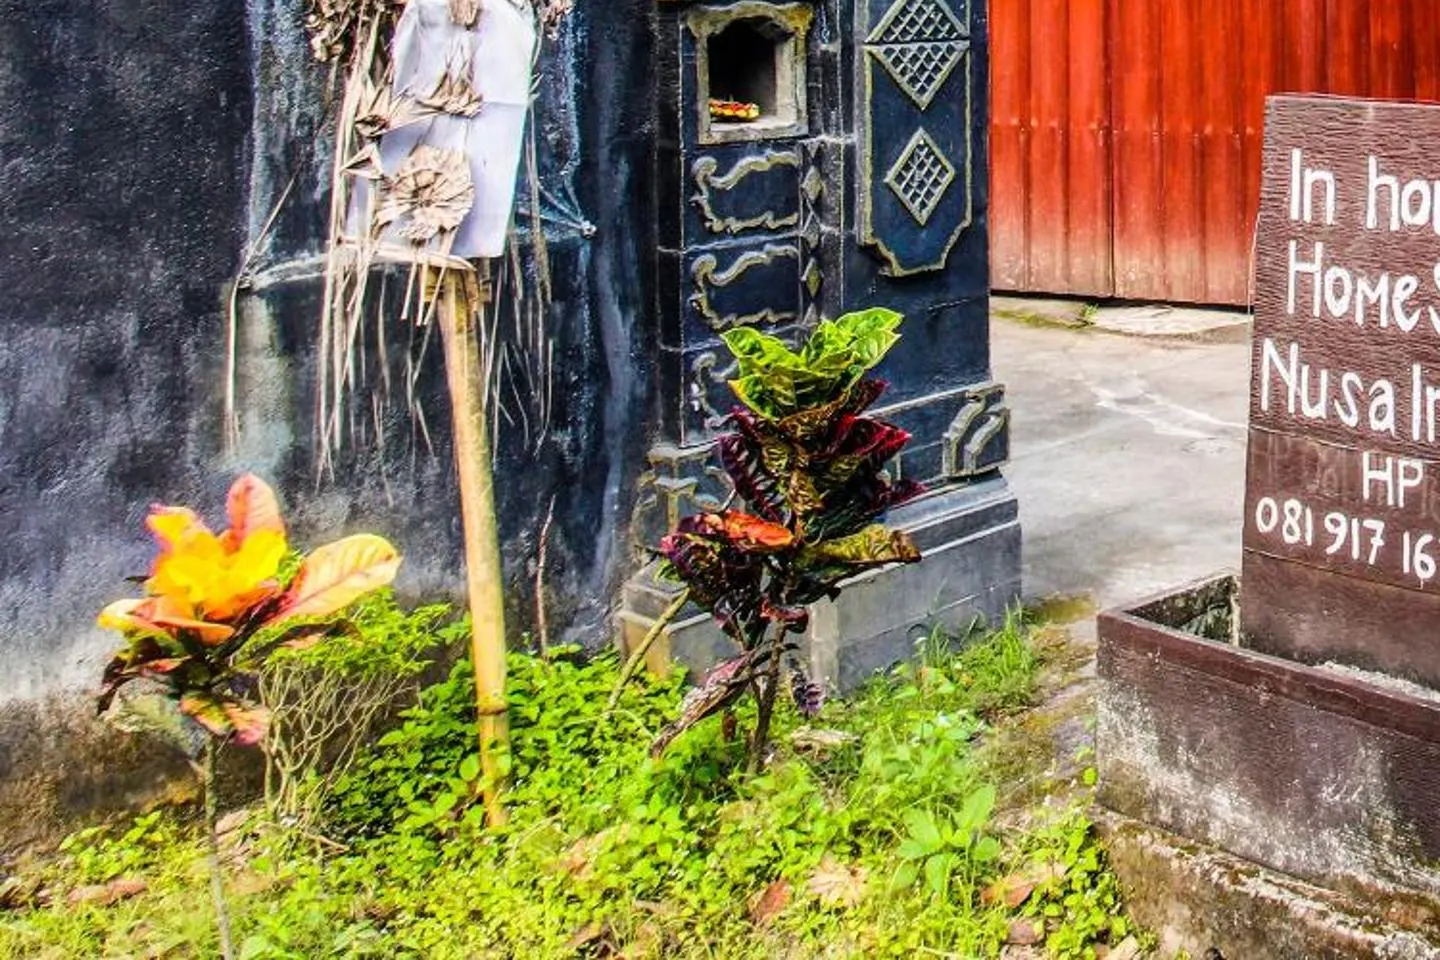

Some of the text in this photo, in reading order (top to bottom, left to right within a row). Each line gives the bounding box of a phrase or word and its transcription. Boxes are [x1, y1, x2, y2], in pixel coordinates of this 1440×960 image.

[1287, 147, 1338, 226] In
[1260, 337, 1397, 439] Nusa
[1360, 449, 1424, 509] HP
[1255, 496, 1314, 547] 081
[1323, 511, 1386, 566] 917
